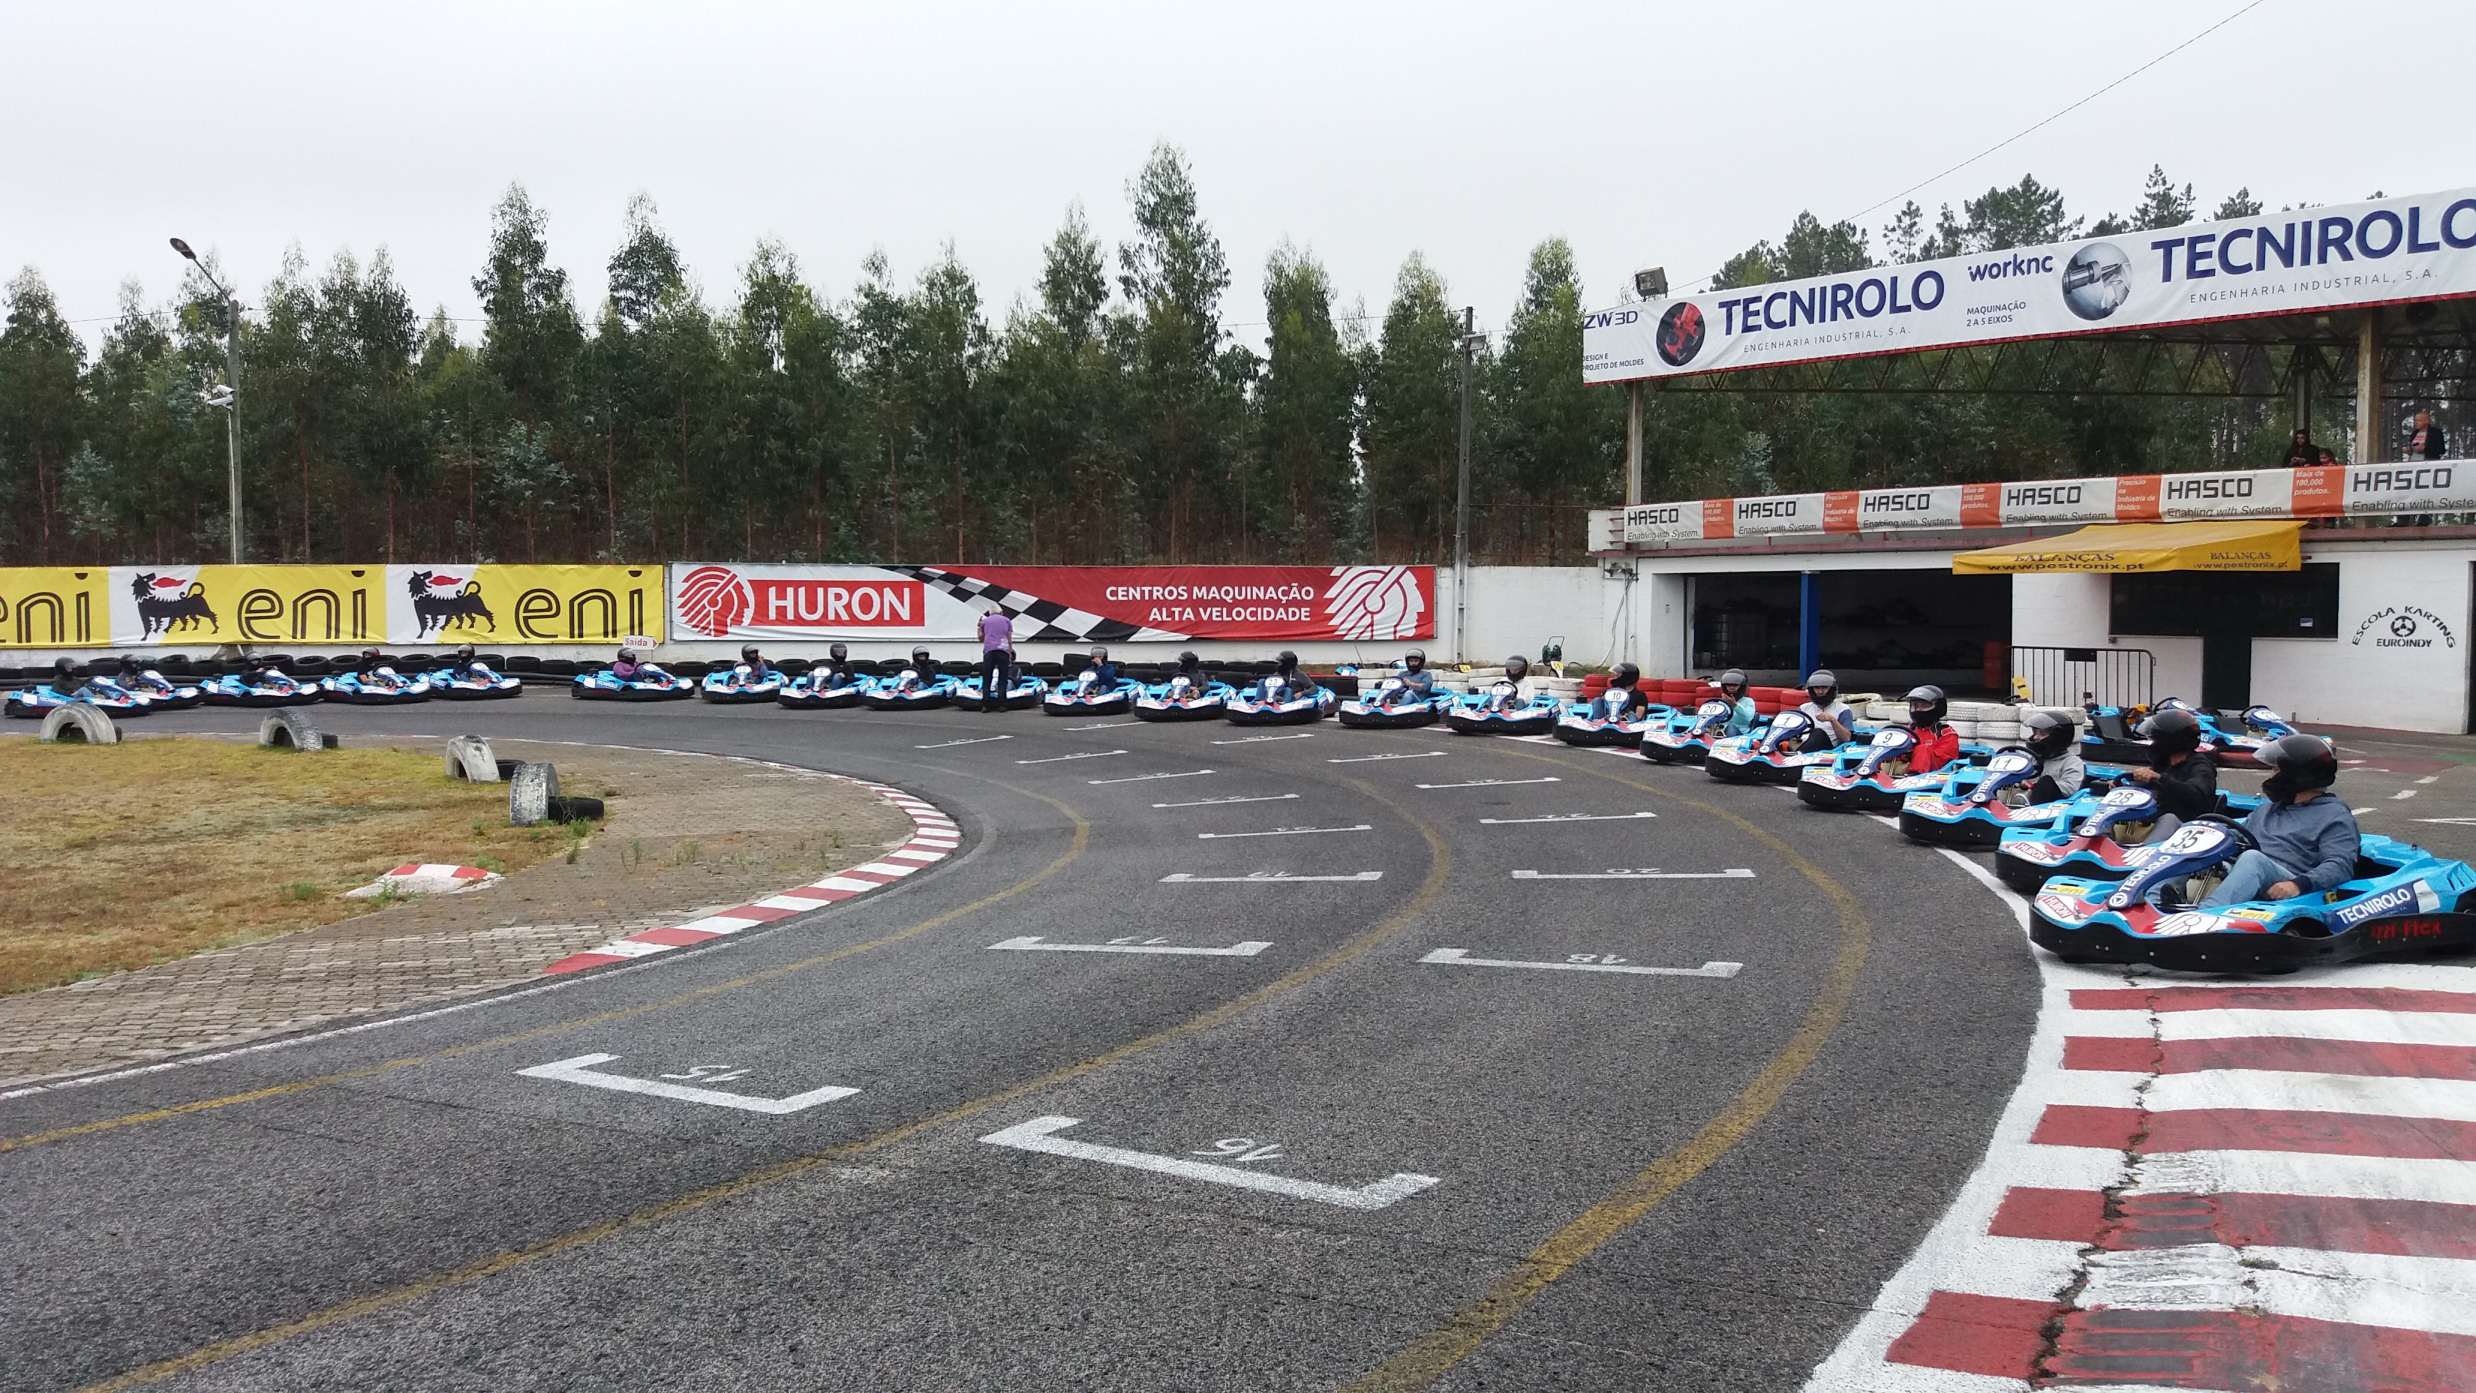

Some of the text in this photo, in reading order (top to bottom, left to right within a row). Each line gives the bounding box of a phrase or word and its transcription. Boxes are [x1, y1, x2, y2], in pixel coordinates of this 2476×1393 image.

[2151, 198, 2476, 283] TECNIROLO
[1968, 254, 2054, 282] worknc
[1718, 270, 1945, 336] TECNIROLO
[2190, 284, 2285, 304] ENGENHARIA
[1966, 301, 2026, 316] MAQUINAÇÃO
[1966, 319, 1972, 328] 2
[1987, 314, 2013, 325] EIXOS
[1744, 336, 1810, 353] ENGENHARIA
[1610, 361, 1618, 369] DE
[1619, 358, 1644, 368] MOLDES
[2168, 477, 2253, 500] HASCO
[2352, 468, 2452, 492] HASCO
[1863, 493, 1931, 512] HASCO
[2007, 486, 2082, 506] HASCO
[2352, 500, 2406, 512] Enabling
[2409, 498, 2434, 510] with
[1627, 508, 1679, 526] HASCO
[1738, 500, 1797, 520] HASCO
[2006, 513, 2047, 522] Enabling
[2048, 512, 2068, 521] with
[2168, 507, 2214, 518] Enabling
[2216, 505, 2237, 516] with
[1738, 525, 1769, 536] Enabling
[1770, 524, 1787, 534] with
[1863, 518, 1899, 529] Enabling
[1901, 517, 1918, 527] with
[1627, 531, 1652, 541] Enabling
[1653, 530, 1670, 539] with
[2014, 553, 2115, 563] BALANÇAS
[2209, 551, 2272, 560] BALANÇAS
[1105, 585, 1188, 601] CENTROS
[1192, 583, 1315, 603] MAQUINAÇÃO
[0, 572, 91, 643] ni
[236, 569, 367, 640] eni
[514, 569, 643, 639] eni
[768, 585, 911, 621] HURON
[1148, 607, 1195, 622] ALTA
[1198, 607, 1311, 622] VELOCIDADE
[2352, 605, 2456, 648] ESCOLA KARTING
[2376, 638, 2432, 648] EUROINDY
[2109, 792, 2134, 805] 28
[2170, 829, 2205, 849] 35
[2336, 888, 2411, 925] TECNIROLO
